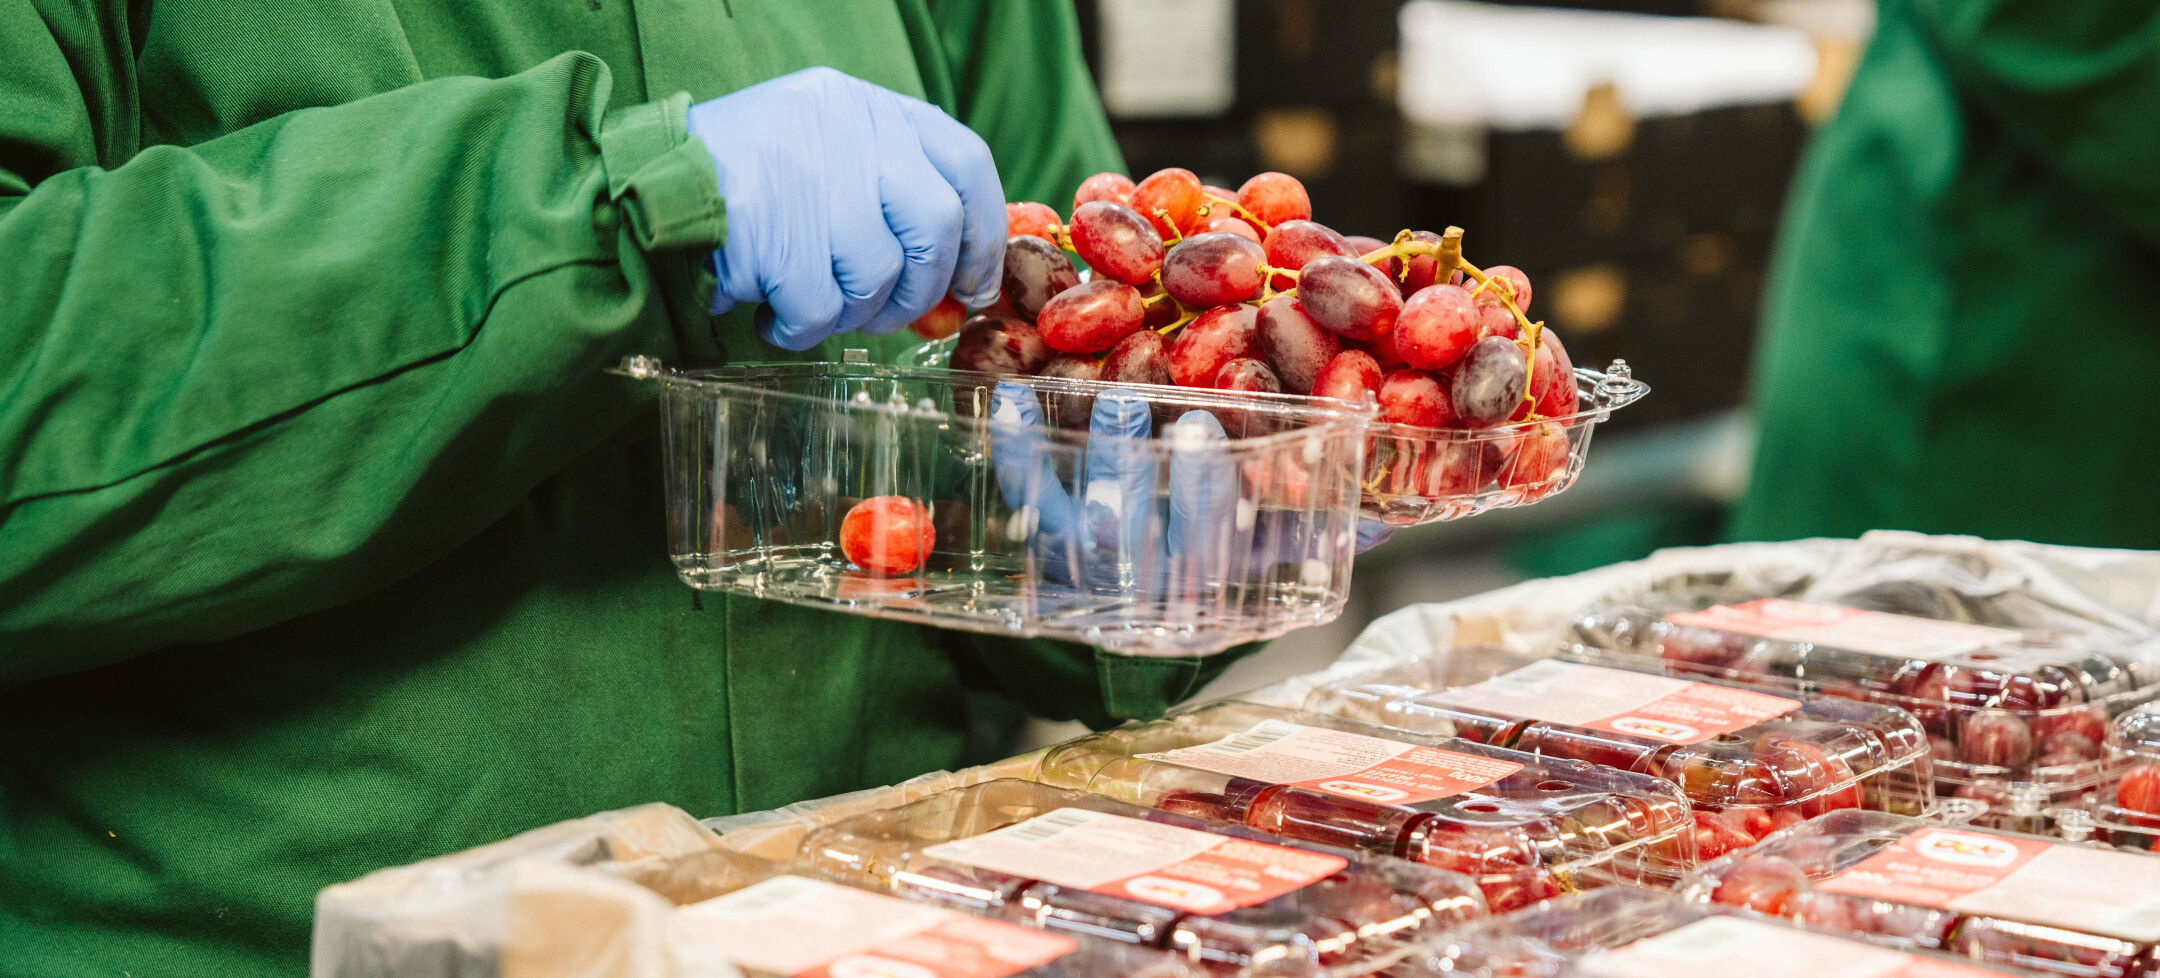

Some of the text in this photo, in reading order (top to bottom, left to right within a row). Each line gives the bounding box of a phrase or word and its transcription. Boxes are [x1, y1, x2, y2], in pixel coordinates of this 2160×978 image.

[1354, 773, 1417, 786] SEEDLESS
[1365, 770, 1415, 781] GRAPES
[1448, 770, 1491, 784] 500g
